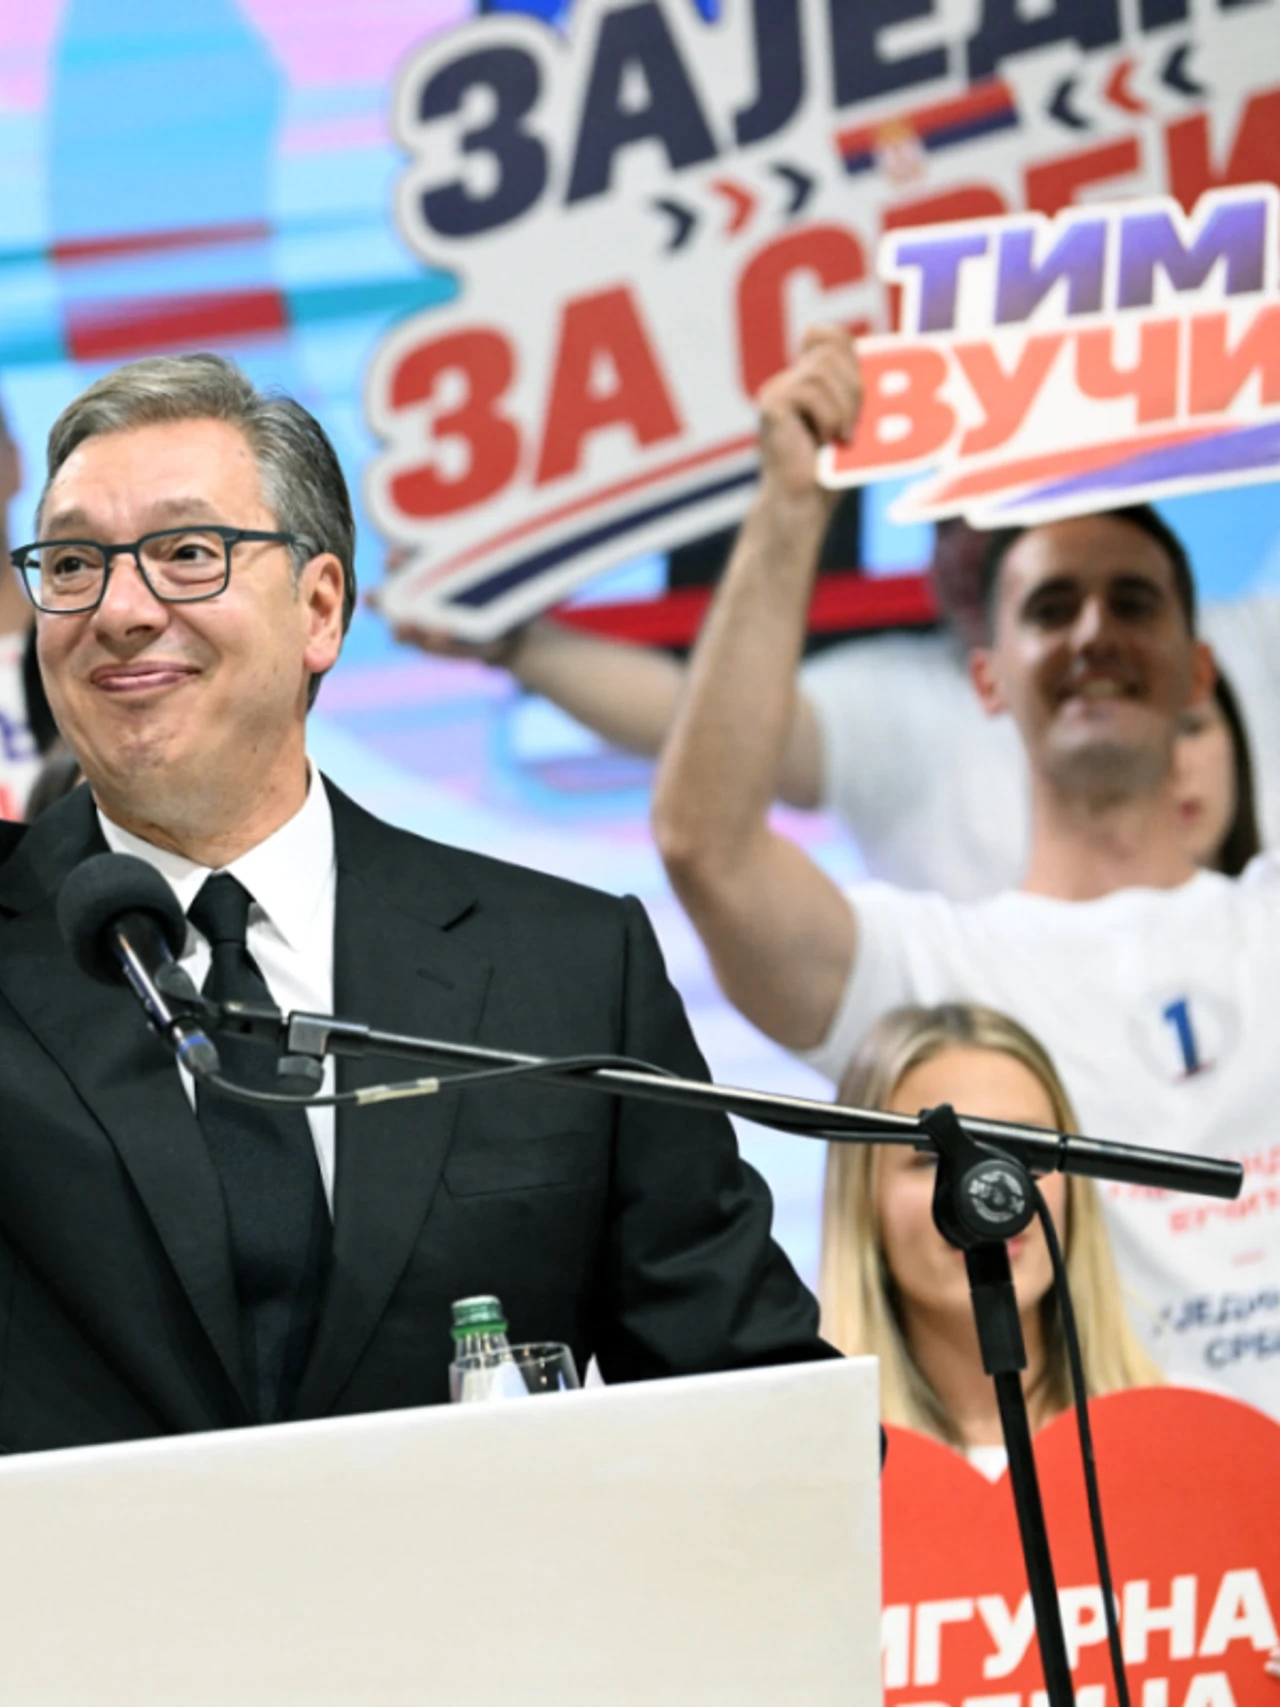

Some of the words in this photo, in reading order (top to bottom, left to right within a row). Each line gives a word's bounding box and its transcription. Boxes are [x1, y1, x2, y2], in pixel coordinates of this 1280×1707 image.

[895, 198, 1268, 335] ТИМ
[388, 282, 687, 520] ЗА
[1163, 998, 1210, 1076] 1
